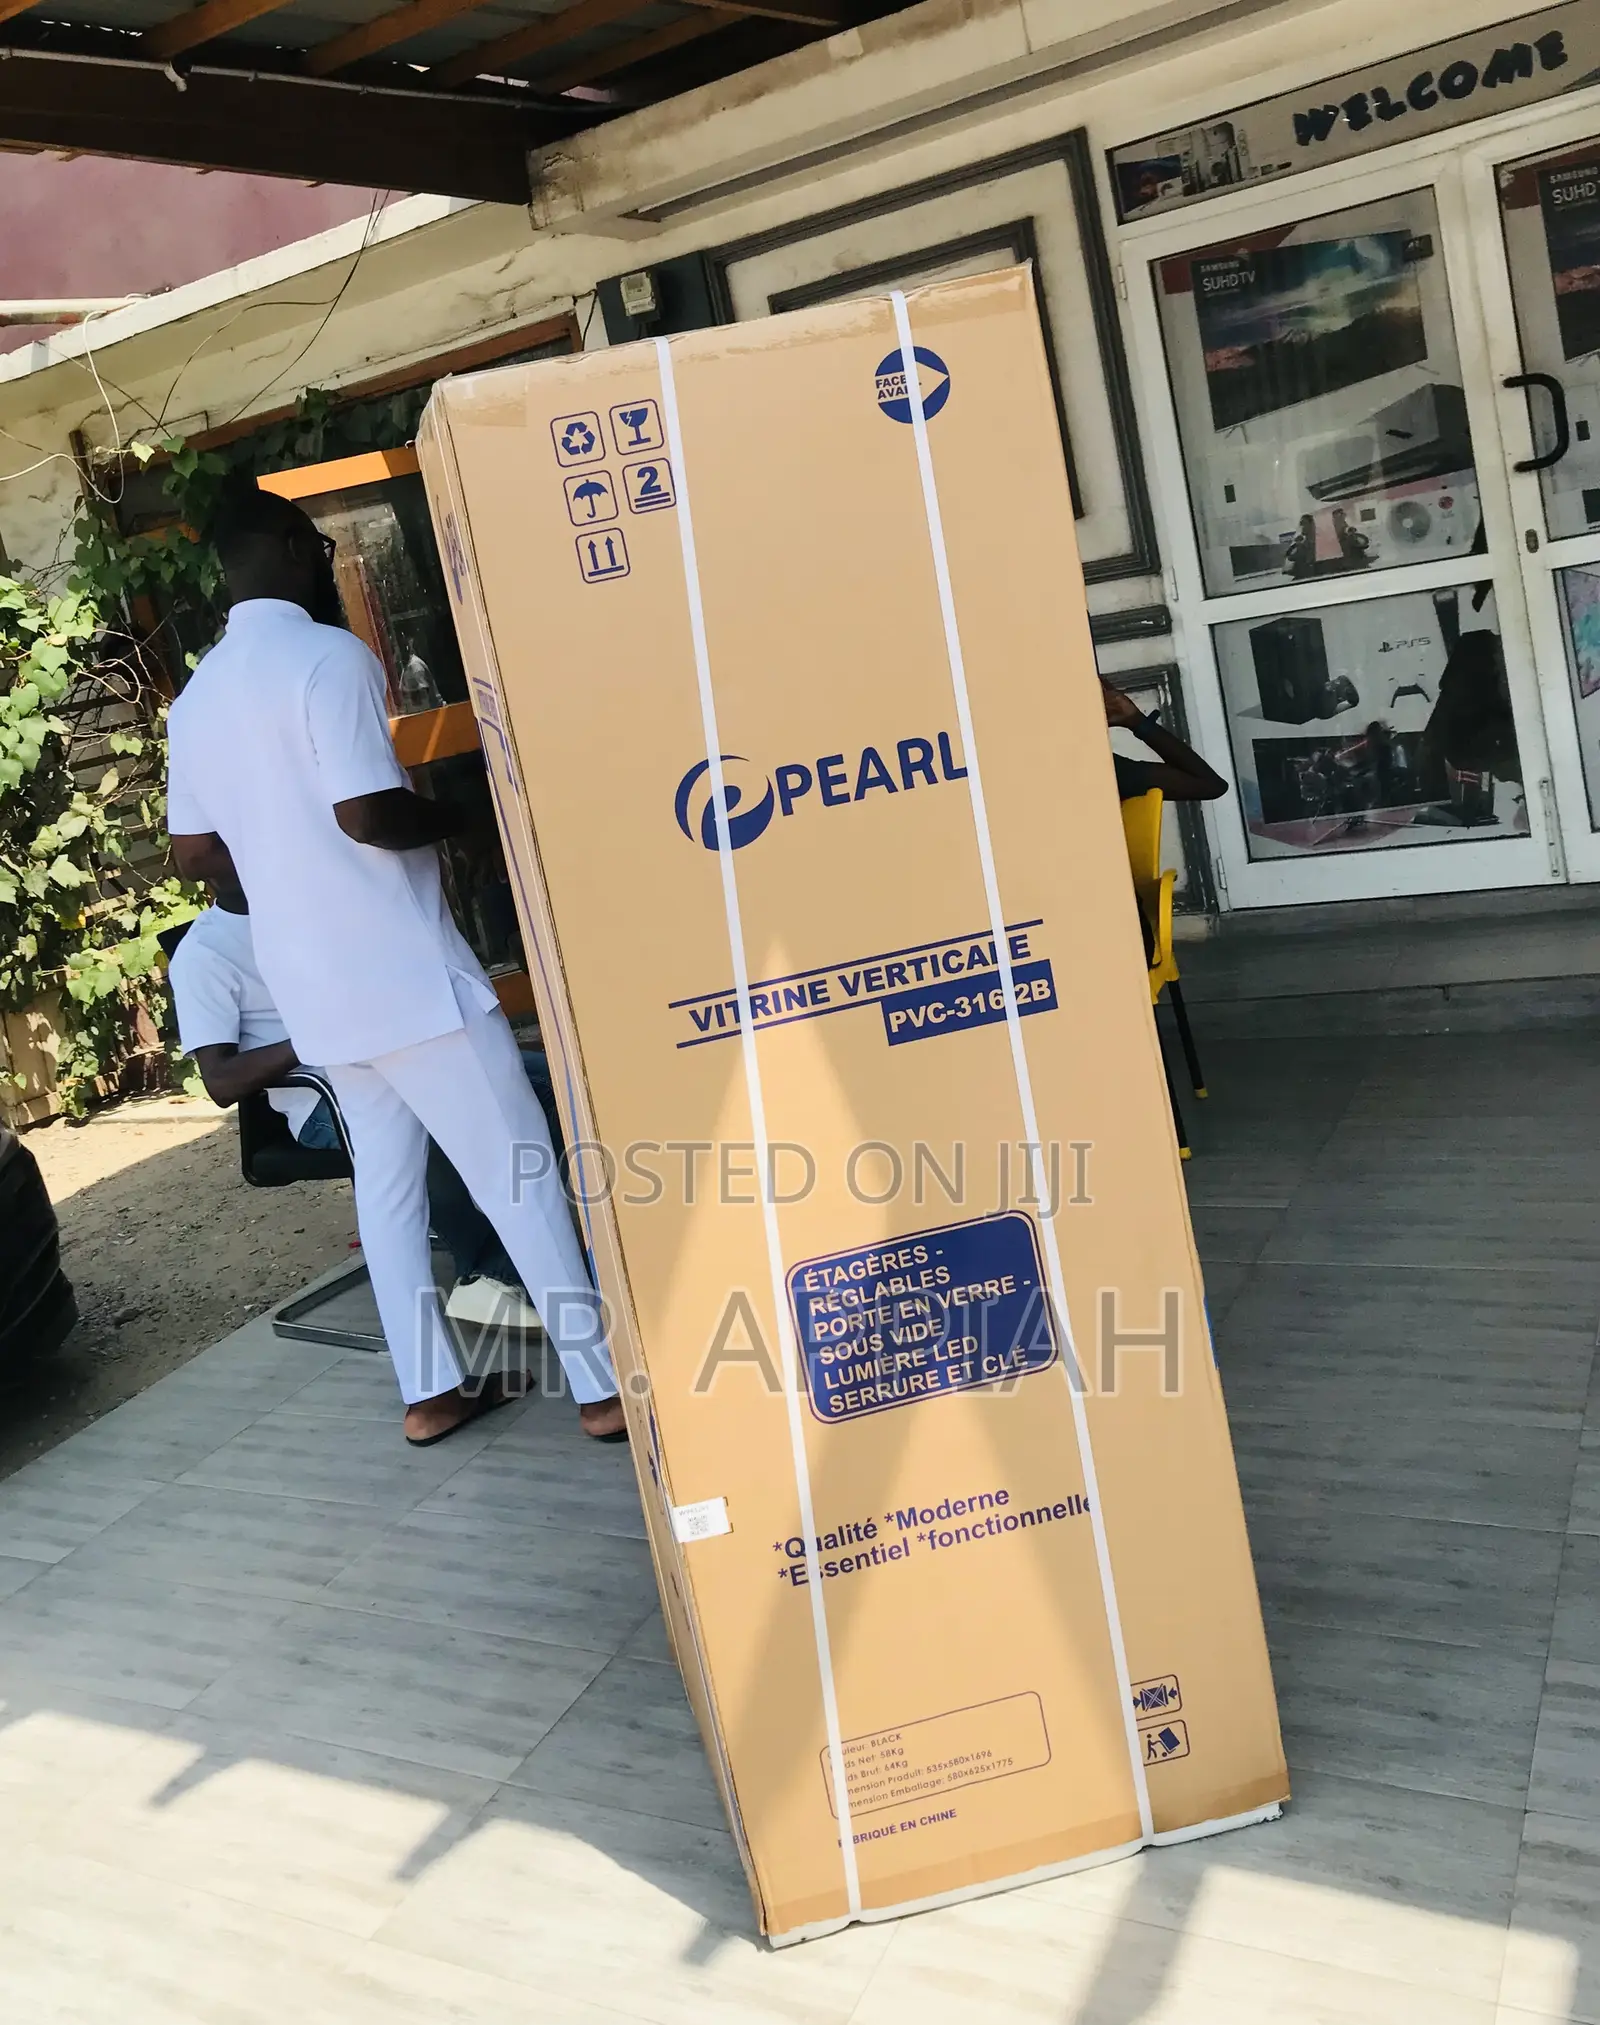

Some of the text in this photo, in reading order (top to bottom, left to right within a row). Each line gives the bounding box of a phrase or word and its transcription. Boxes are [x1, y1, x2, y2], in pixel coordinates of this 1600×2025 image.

[1293, 30, 1568, 147] WELCOME
[1552, 180, 1600, 204] SUHD
[875, 374, 907, 389] FACE
[878, 382, 921, 400] AVA
[637, 466, 661, 496] 2
[775, 731, 968, 817] PEARL
[689, 979, 830, 1032] VITRINE
[804, 1244, 929, 1293] ÉTAGÈRES
[809, 1265, 951, 1317] RÉGLABLES
[813, 1302, 894, 1341] PORTE
[900, 1296, 931, 1320] EN
[936, 1275, 1017, 1309] VERRE
[819, 1318, 945, 1366] SOUS VIDE
[824, 1336, 979, 1390] LUMIÈRE LED
[829, 1347, 1029, 1414] SERRURE ET CLÉ
[778, 1537, 911, 1586] Esentiel
[871, 1733, 902, 1748] BLACK
[880, 1747, 904, 1759] 58Kg
[847, 1780, 886, 1795] mension
[884, 1760, 908, 1772] 64Kg
[849, 1793, 889, 1808] mension
[838, 1808, 957, 1848] BRIQUÉ EN CHINE
